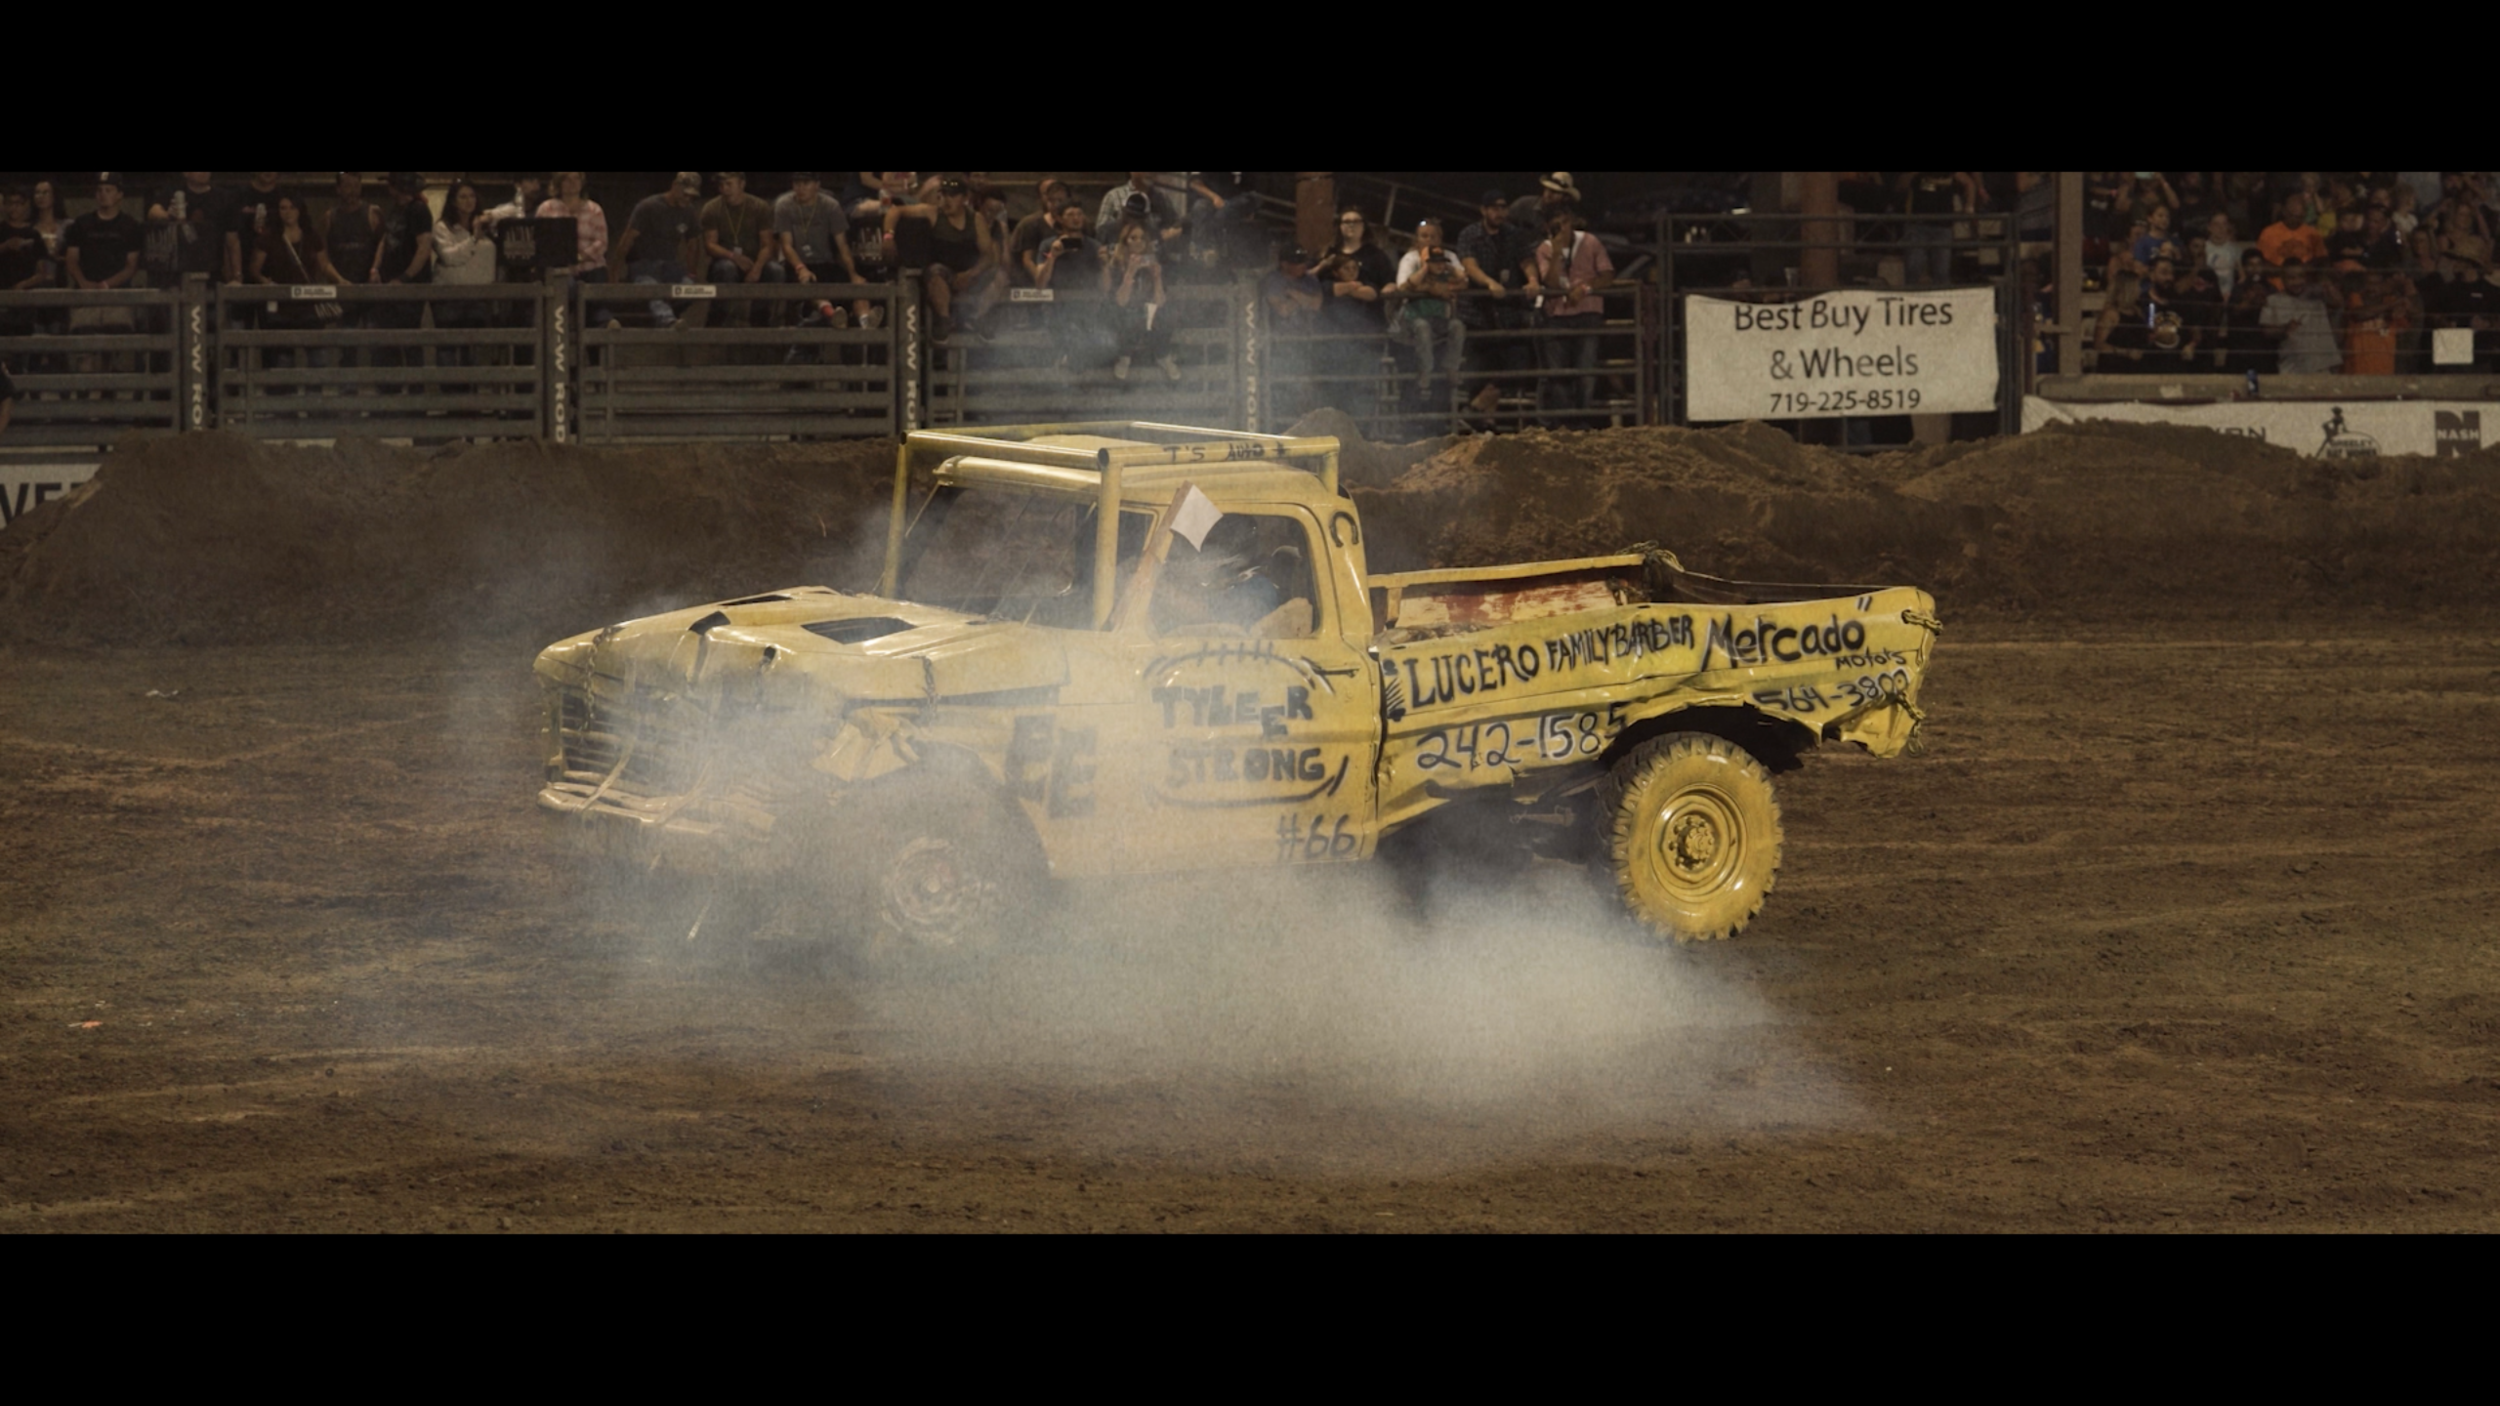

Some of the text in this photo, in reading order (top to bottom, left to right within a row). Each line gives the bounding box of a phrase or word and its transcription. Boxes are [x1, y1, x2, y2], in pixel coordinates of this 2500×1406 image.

[1735, 296, 1953, 336] Best Buy Tires
[1770, 345, 1919, 380] & Wheels
[1770, 388, 1921, 413] 719-225-8519
[1403, 642, 1540, 708] LUCERO
[1545, 627, 1609, 672] FAMILY
[1609, 615, 1694, 657] BARBER
[1165, 746, 1325, 789] STRONG
[1275, 812, 1357, 862] #66
